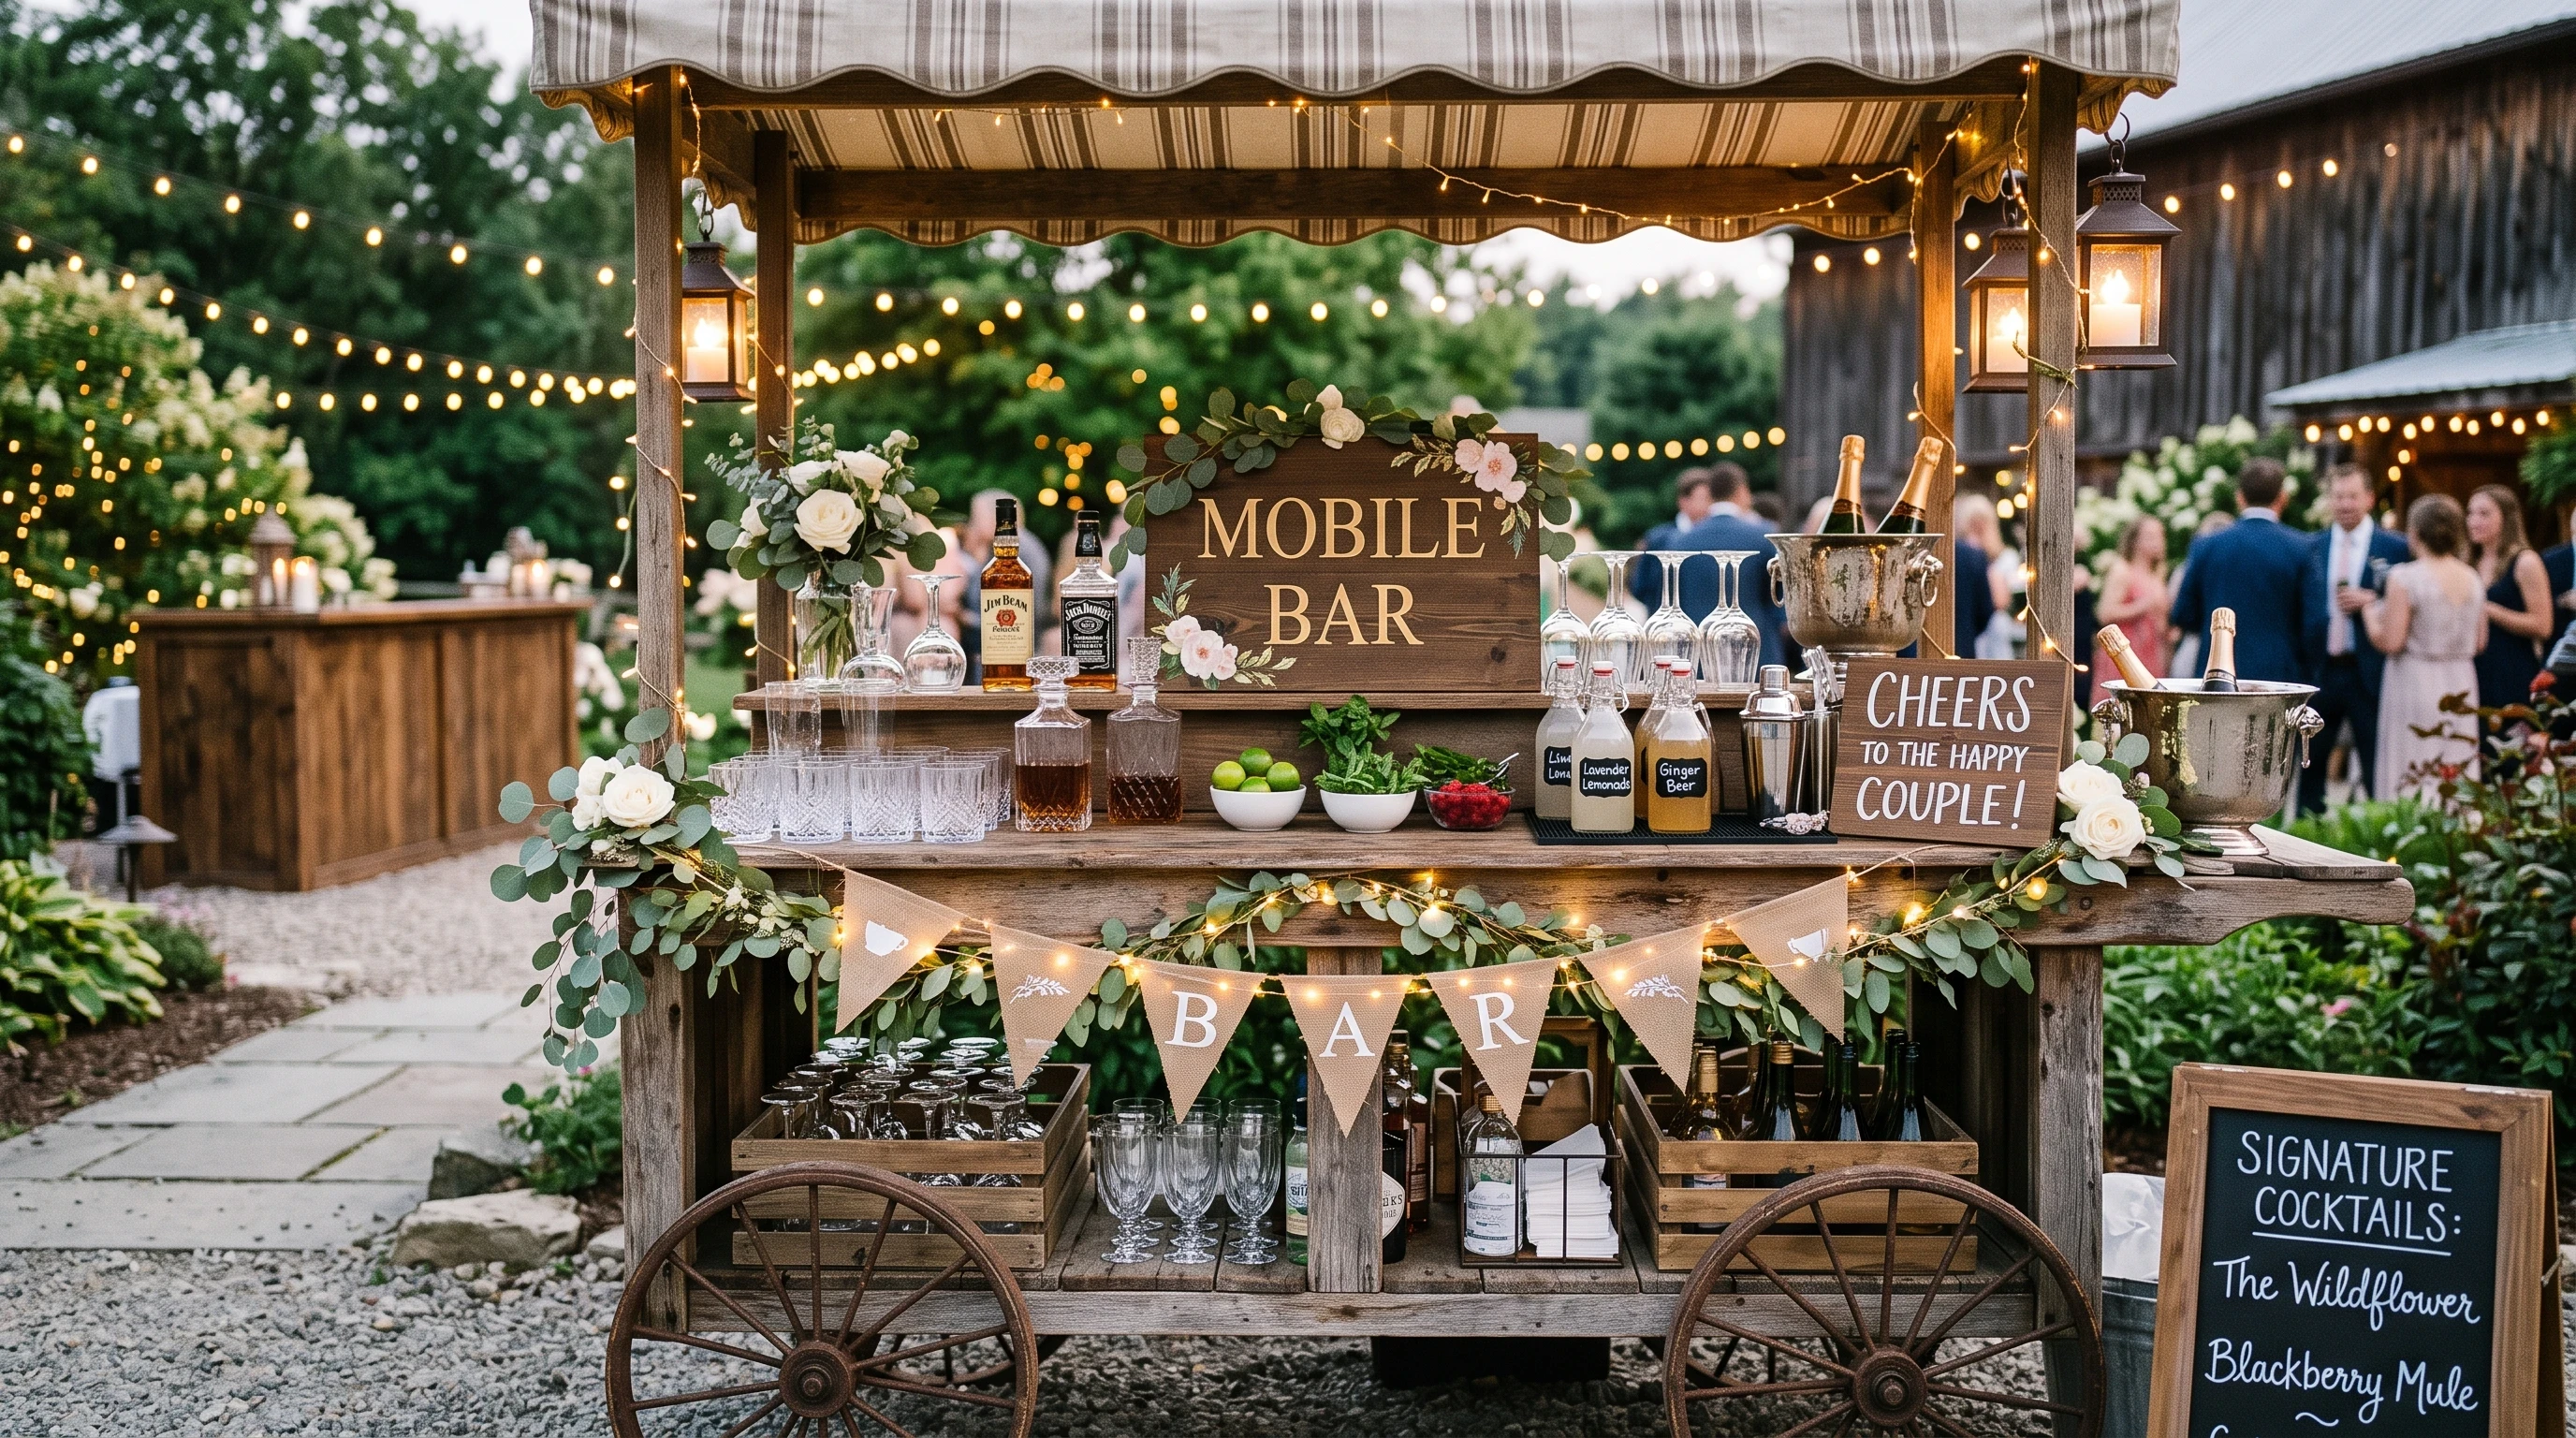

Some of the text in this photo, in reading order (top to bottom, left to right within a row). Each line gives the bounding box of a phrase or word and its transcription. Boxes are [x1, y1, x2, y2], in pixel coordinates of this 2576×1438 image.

[1197, 497, 1486, 559] MOBILE
[984, 598, 1002, 613] JIM
[1264, 582, 1425, 646] BAR
[1866, 671, 2035, 733] CHEERS
[1583, 762, 1630, 775] Lavender
[1660, 762, 1701, 780] Ginger
[1666, 778, 1696, 793] Beer
[1860, 741, 2030, 773] TO THE HAPPY
[1856, 776, 2026, 830] COUPLE!
[2237, 1130, 2454, 1193] SIGNATURE
[2254, 1185, 2461, 1243] COCKTAILS:
[2213, 1255, 2481, 1331] The Wildflower
[2204, 1338, 2479, 1424] Blackberry Mule
